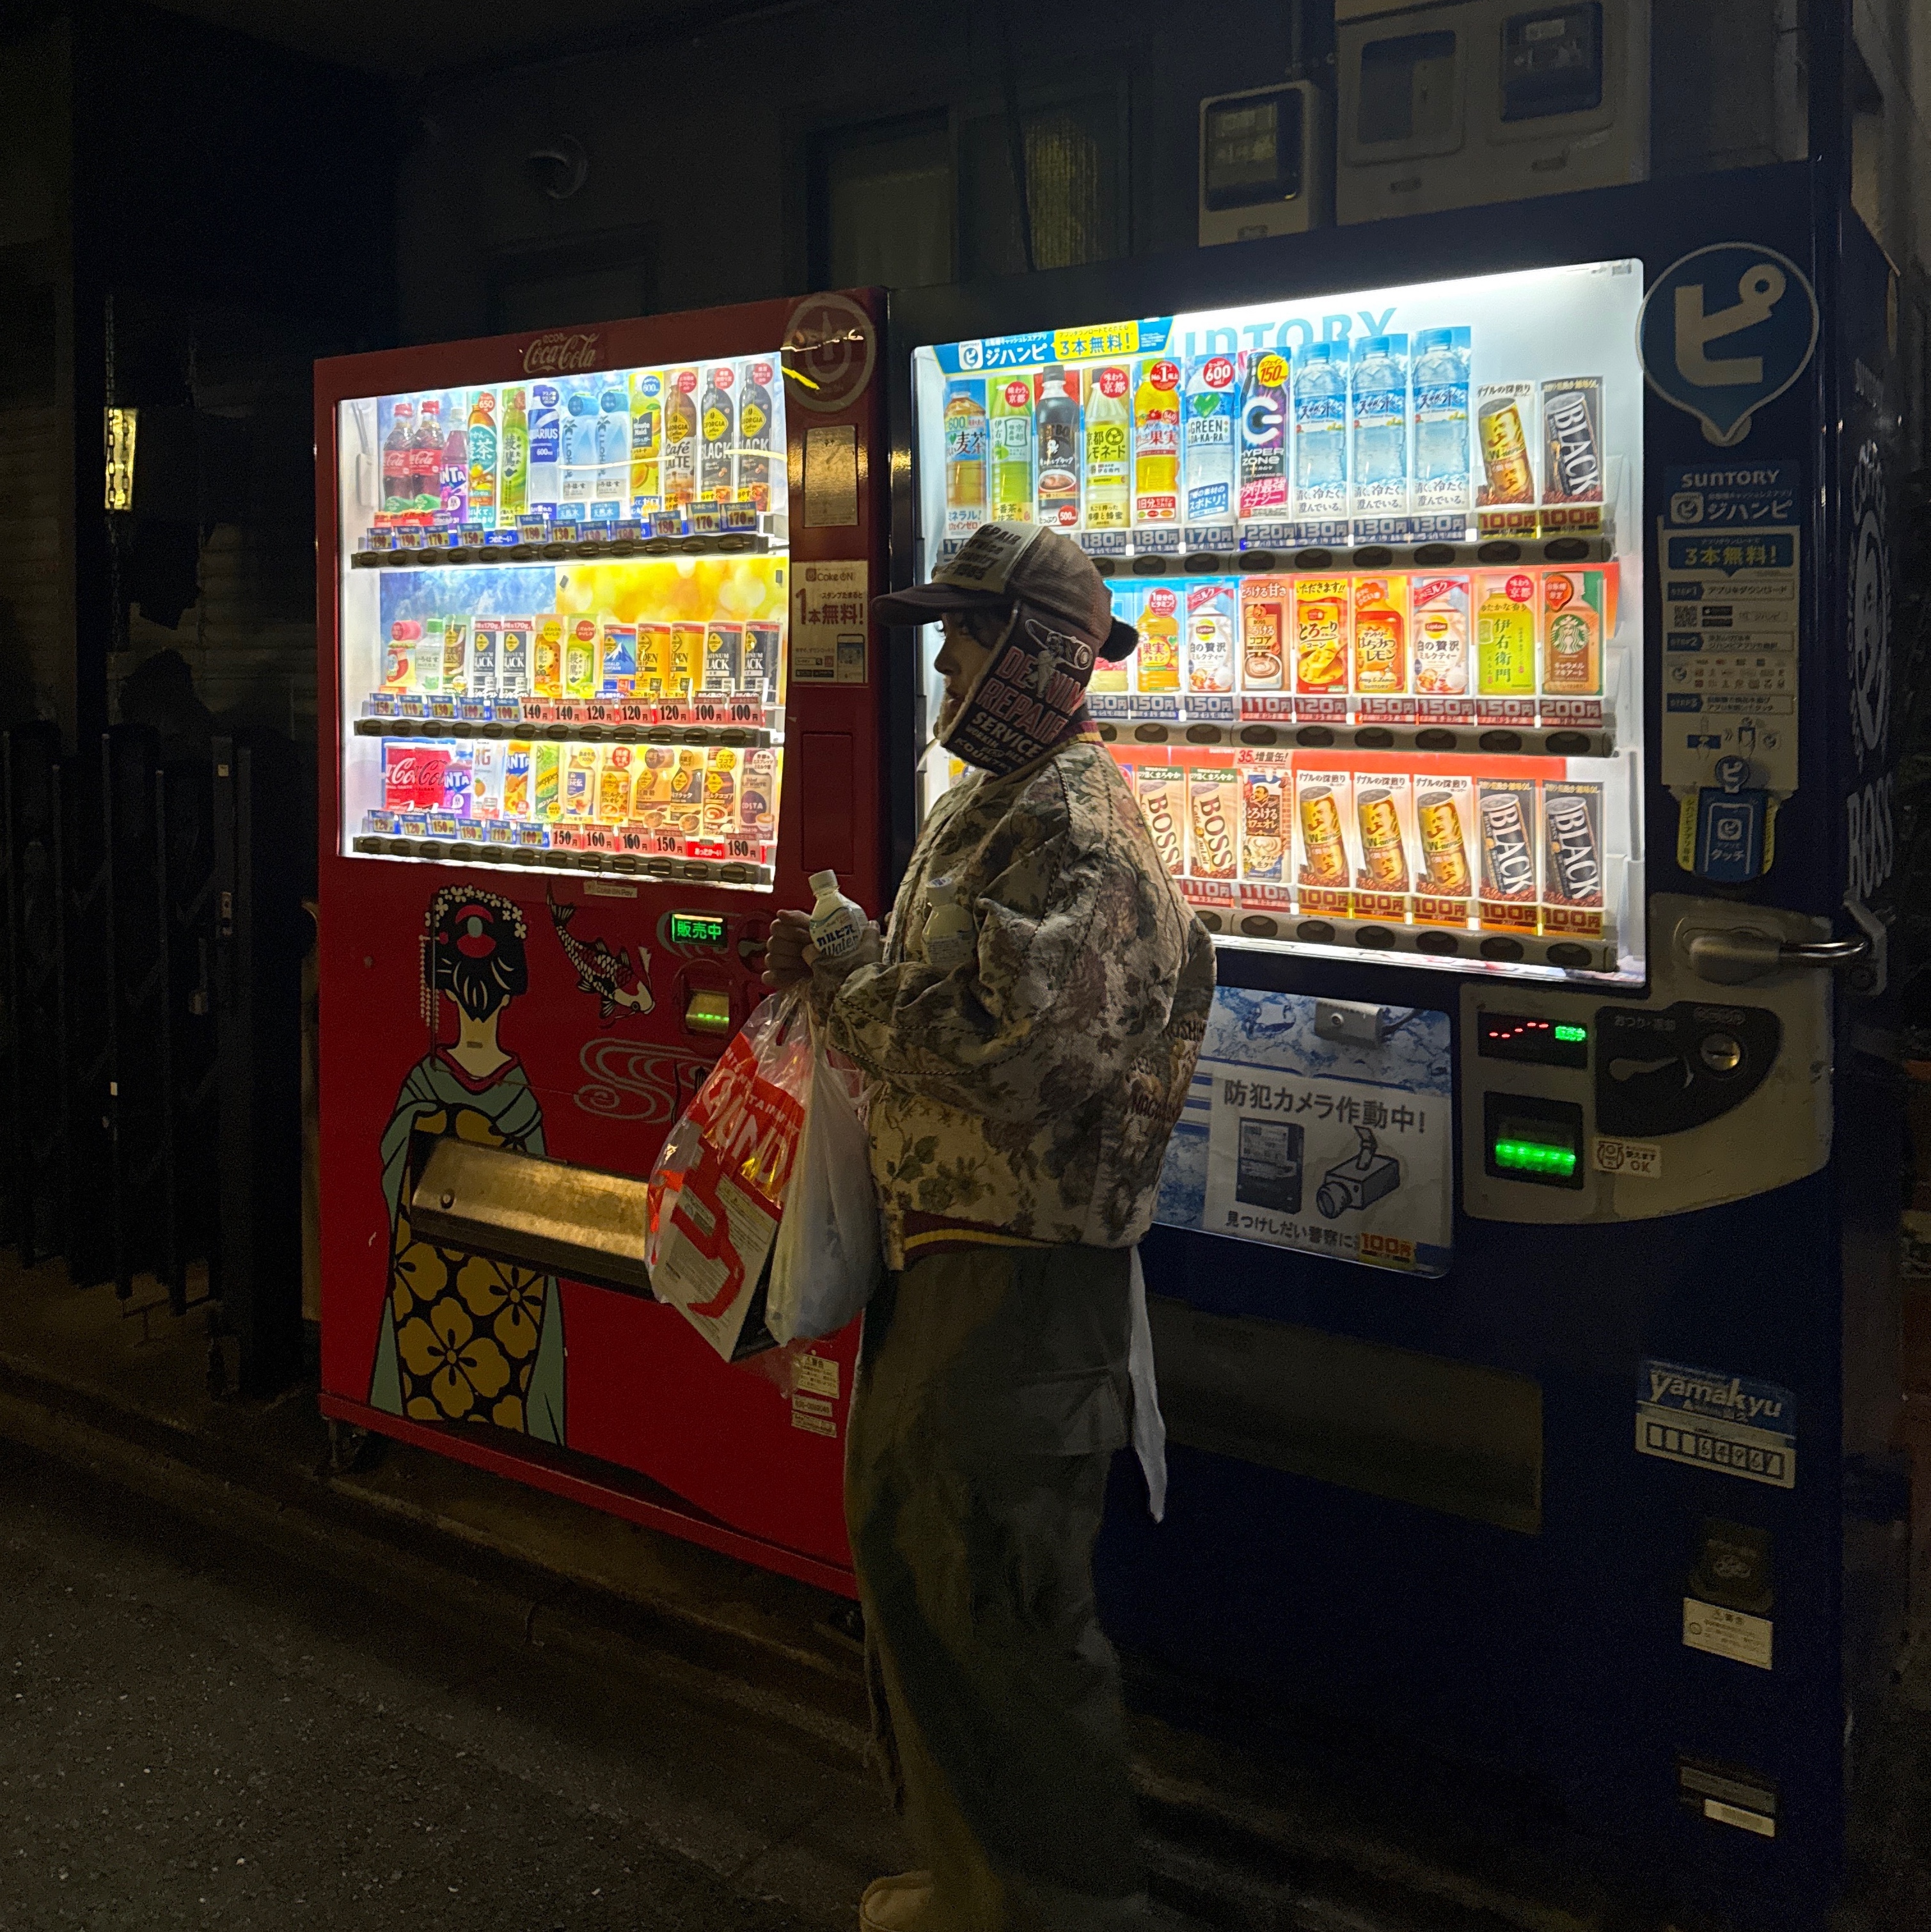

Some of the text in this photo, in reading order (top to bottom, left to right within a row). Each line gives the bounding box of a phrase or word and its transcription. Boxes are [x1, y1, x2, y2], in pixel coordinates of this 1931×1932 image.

[1674, 263, 1786, 388] ピ
[1060, 332, 1131, 356] 3本無料!
[984, 344, 1047, 365] ジハンピ
[1205, 365, 1231, 382] 600
[1103, 383, 1125, 393] 京都
[479, 400, 493, 408] 650
[1009, 394, 1025, 404] 京都
[530, 429, 558, 439] UARIUS
[1190, 419, 1223, 434] GREEN
[956, 431, 986, 455] 麦茶
[1151, 430, 1178, 446] 果実
[666, 441, 690, 455] Café
[1555, 404, 1600, 495] BLACK
[1681, 469, 1781, 489] SUNTORY
[1189, 495, 1226, 511] スポドリ!
[1708, 498, 1793, 521] ジハンピ
[729, 512, 753, 526] 170円
[1413, 516, 1465, 532] 130円
[1480, 512, 1535, 529] 100円
[1543, 510, 1598, 525] 100円
[979, 525, 1022, 545] EPAIR
[1248, 525, 1295, 539] 220円
[1298, 523, 1346, 538] 130円
[1357, 519, 1406, 535] 130円
[1082, 533, 1125, 547] 180円
[1135, 531, 1178, 546] 180円
[1185, 528, 1232, 544] 170円
[1685, 546, 1777, 566] 3本無料!
[817, 573, 839, 582] Coke
[1241, 583, 1286, 598] とろける甘さ
[1511, 588, 1531, 598] 京都
[796, 588, 863, 625] 1本無料!
[1143, 643, 1165, 654] 果実
[1250, 637, 1271, 645] ココア
[1358, 637, 1396, 649] はちみつ
[1417, 640, 1460, 651] 白の贅沢
[1366, 649, 1395, 661] レモン
[1495, 619, 1512, 683] 伊右衛門
[707, 659, 730, 670] LACK
[1088, 697, 1127, 709] 150円
[1131, 697, 1174, 709] 150円
[1186, 698, 1231, 710] 150円
[1243, 698, 1291, 713] 110円
[1298, 698, 1343, 713] 120円
[1364, 698, 1414, 714] 150円
[1421, 701, 1474, 716] 150円
[1477, 701, 1534, 716] 150円
[1541, 701, 1600, 717] 200円
[522, 704, 548, 720] 140円
[556, 704, 579, 721] 140円
[587, 704, 611, 722] 120円
[623, 704, 648, 722] 120円
[659, 704, 687, 722] 120円
[695, 704, 722, 722] 100円
[730, 704, 759, 722] 100円
[974, 678, 1069, 745] REPAIR
[972, 711, 1044, 757] SERVICE
[1148, 793, 1180, 864] BOSS
[1199, 795, 1233, 867] BOSS
[553, 830, 578, 846] 150円
[587, 832, 612, 848] 160円
[623, 834, 648, 851] 160円
[656, 836, 683, 853] 150円
[729, 839, 756, 857] 180円
[1488, 806, 1534, 894] BLACK
[1555, 810, 1600, 899] BLACK
[1710, 850, 1745, 862] タッチ
[1186, 880, 1229, 896] 110円
[1243, 884, 1289, 899] 110円
[1299, 891, 1348, 905] 100円
[1355, 894, 1404, 912] 100円
[1414, 897, 1466, 915] 100円
[1481, 903, 1535, 921] 100円
[1545, 908, 1598, 928] 100円
[677, 921, 721, 940] 販売中
[816, 924, 855, 947] カルピス
[1224, 1079, 1426, 1134] 防犯カメラ作動中!
[1631, 1160, 1651, 1173] OK
[1226, 1211, 1361, 1251] 見つけしだい警察に
[1361, 1233, 1411, 1258] 100円
[1649, 1370, 1782, 1418] yamakyu
